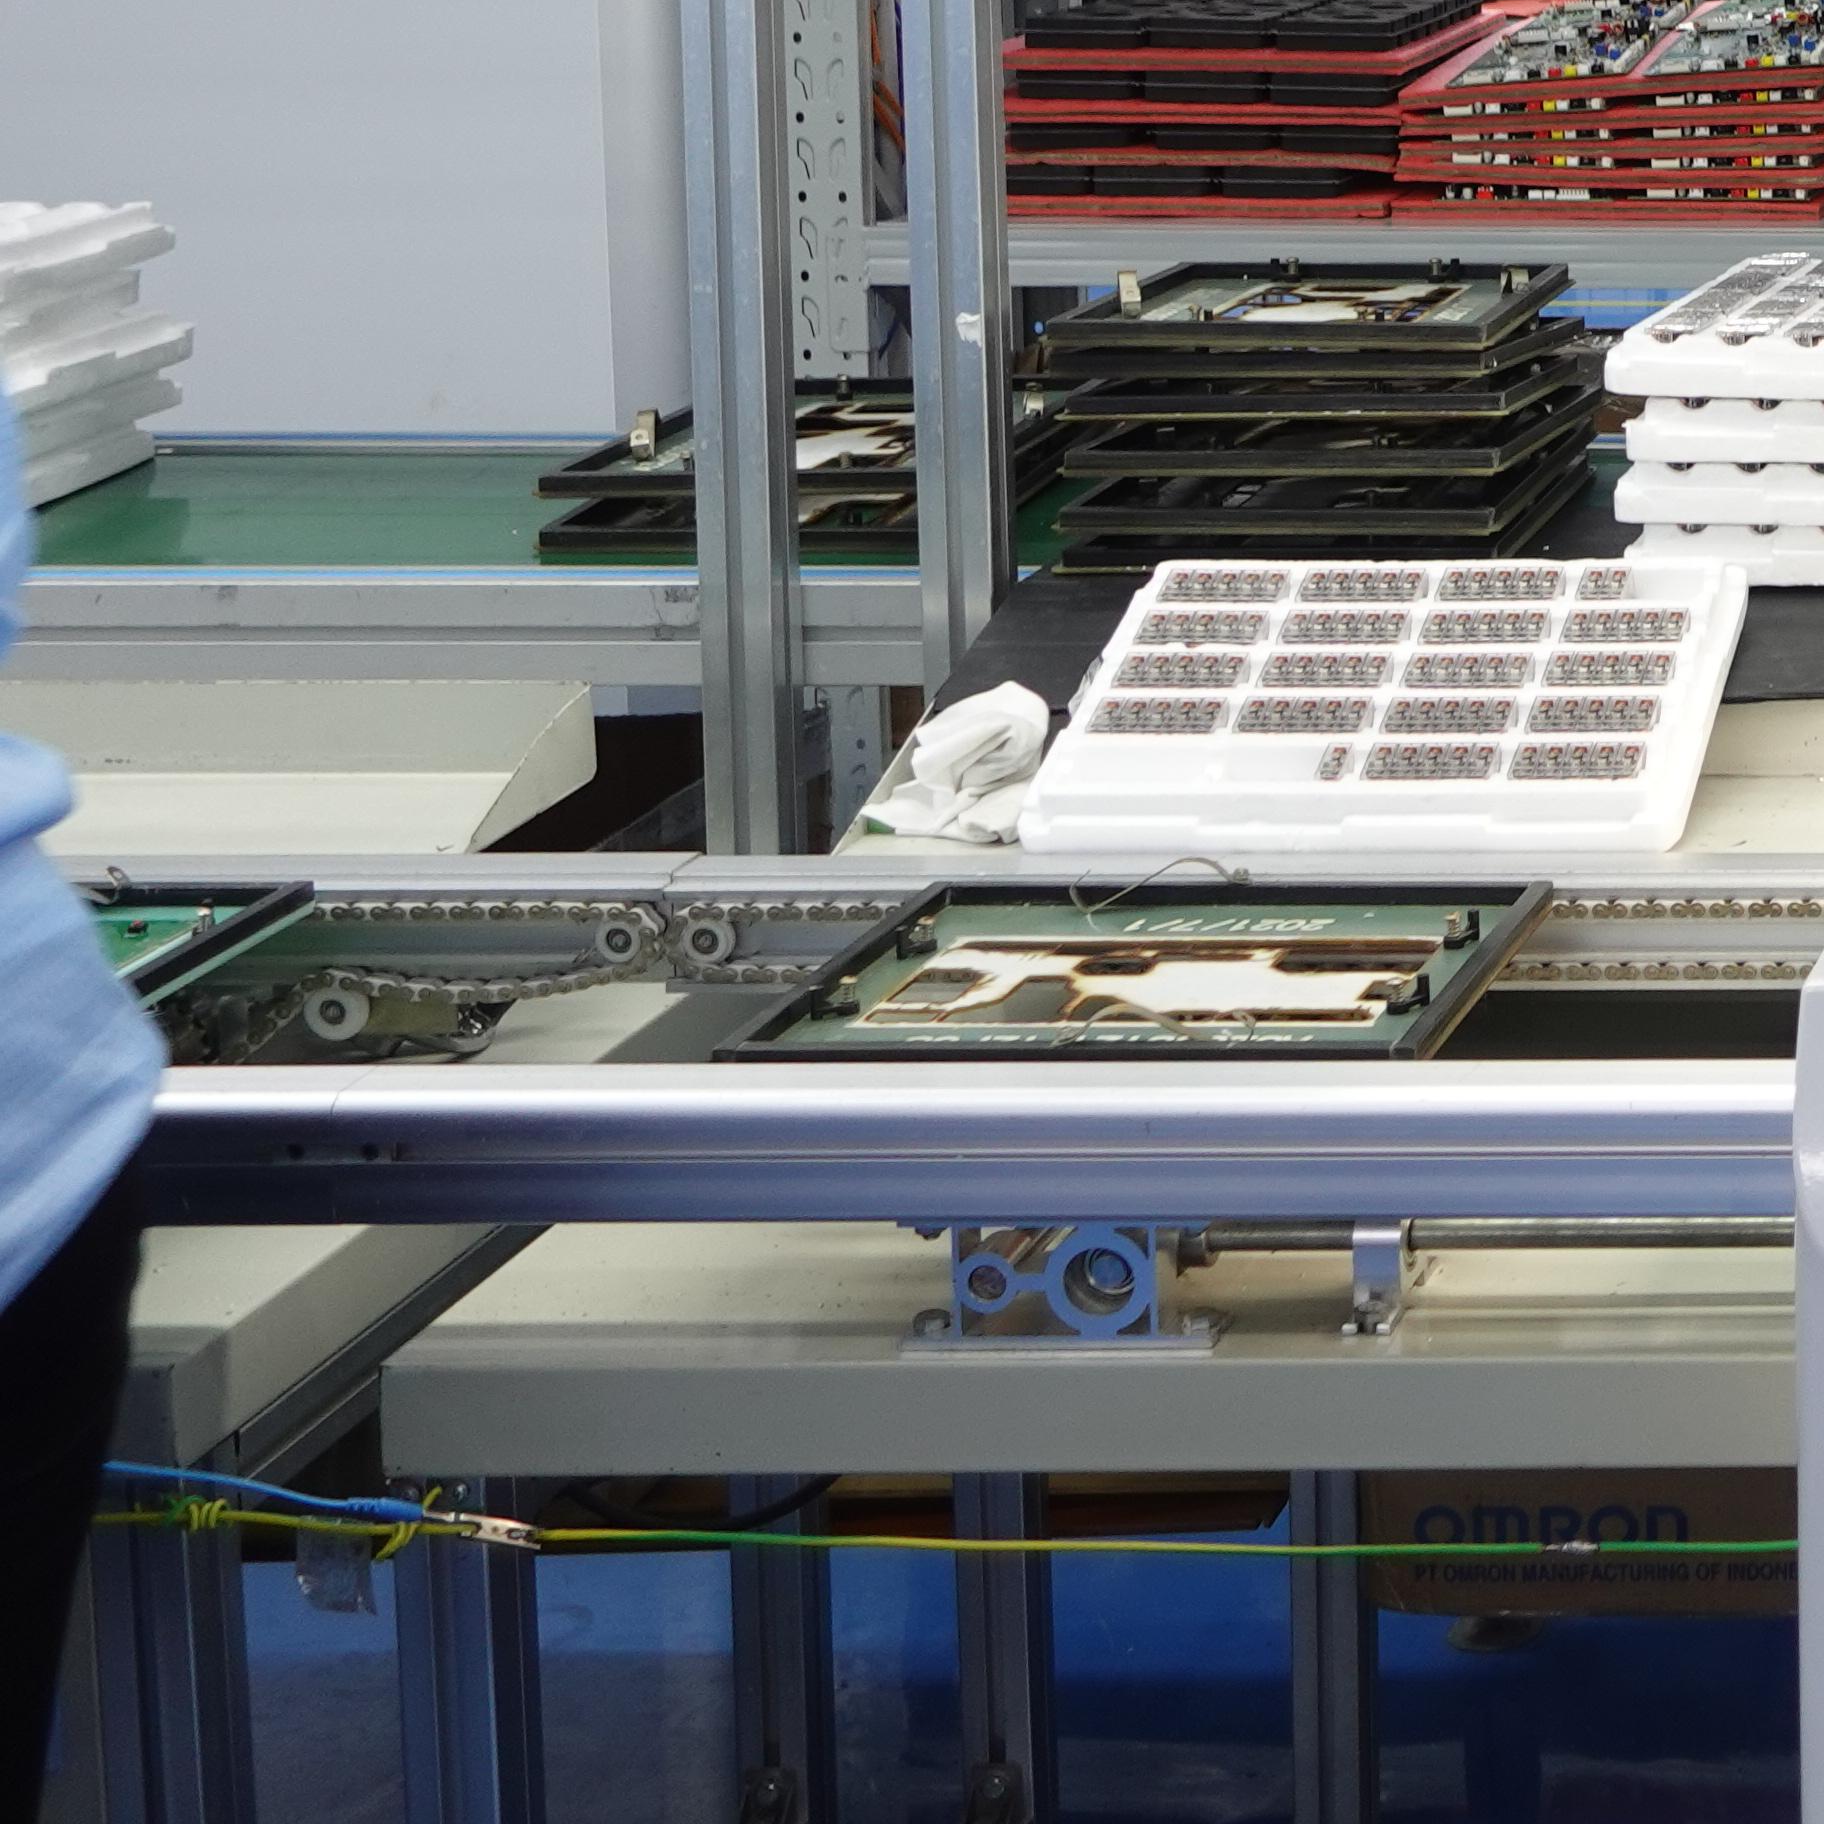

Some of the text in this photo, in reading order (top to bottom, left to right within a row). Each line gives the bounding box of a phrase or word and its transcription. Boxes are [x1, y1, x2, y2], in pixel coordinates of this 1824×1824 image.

[1123, 917, 1337, 933] 2021/7/1
[1444, 1563, 1517, 1583] OMRON
[1522, 1562, 1688, 1583] MANUFACTURING
[1696, 1561, 1719, 1581] OF
